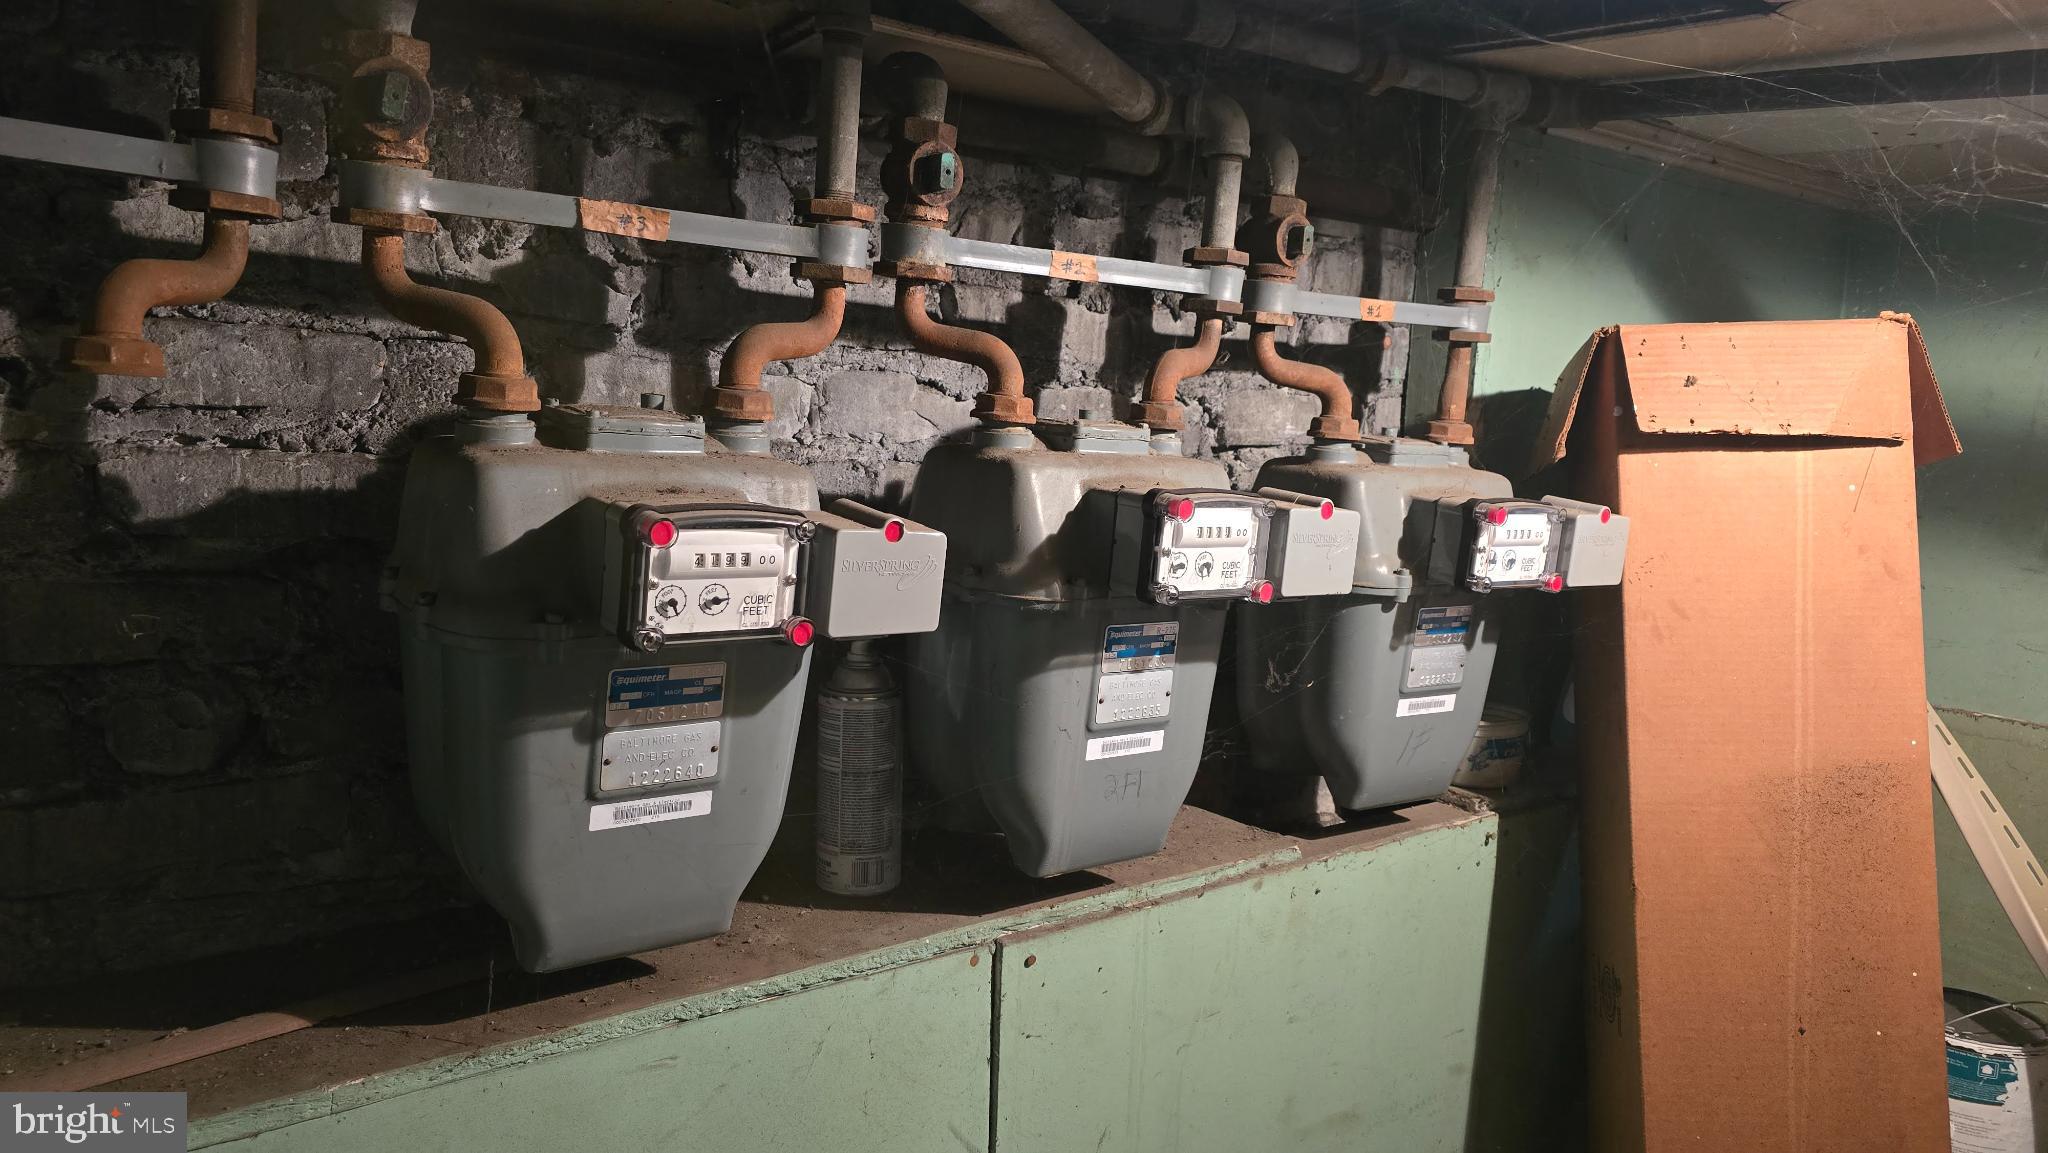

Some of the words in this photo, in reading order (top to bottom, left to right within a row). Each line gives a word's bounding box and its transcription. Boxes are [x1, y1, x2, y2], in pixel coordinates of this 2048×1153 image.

[743, 595, 773, 605] CUBIC
[743, 606, 769, 616] FEET
[620, 734, 677, 749] BALTIMORE
[683, 732, 702, 743] GAS
[624, 752, 645, 764] AND
[628, 763, 704, 786] 1222640
